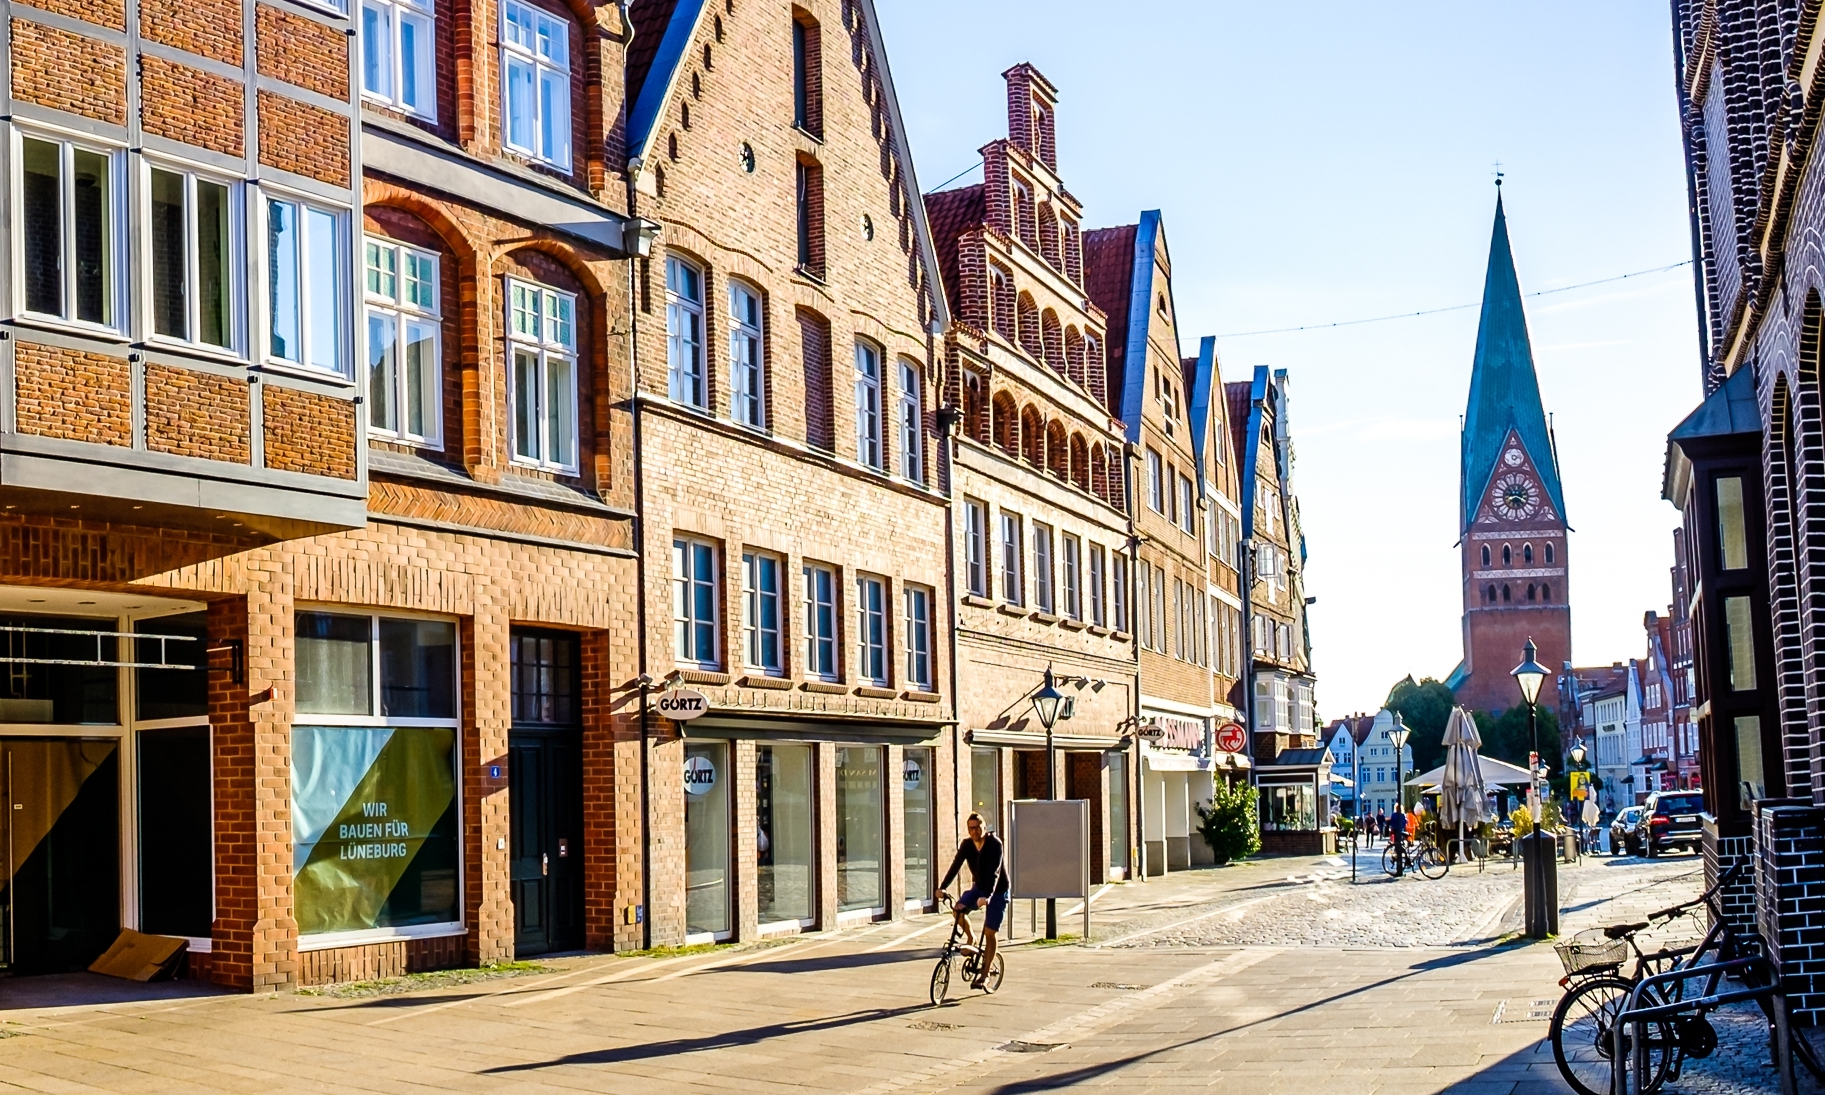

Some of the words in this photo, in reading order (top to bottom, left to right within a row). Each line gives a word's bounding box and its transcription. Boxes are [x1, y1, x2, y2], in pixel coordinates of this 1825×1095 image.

[362, 802, 387, 817] WIR
[339, 823, 382, 839] BAUEN
[385, 819, 409, 837] FÜR
[340, 842, 407, 860] LÜNEBURG
